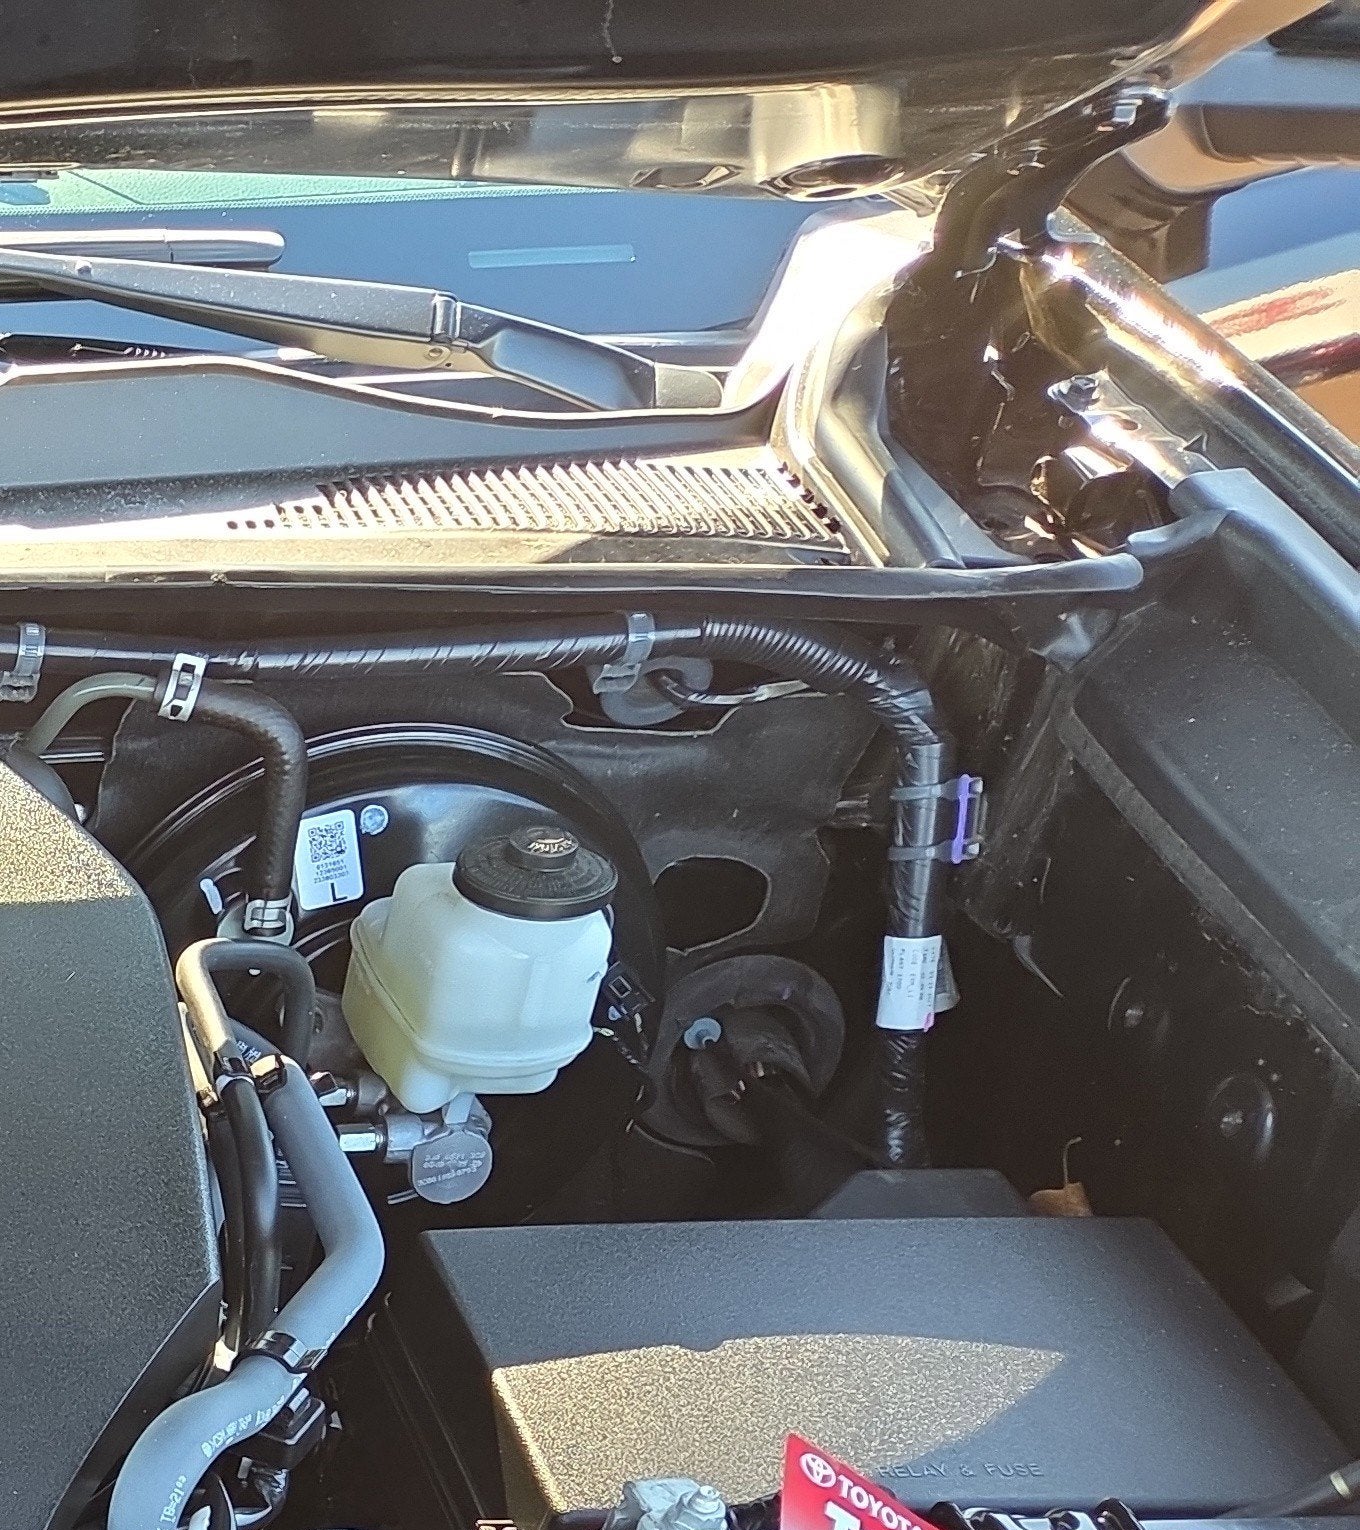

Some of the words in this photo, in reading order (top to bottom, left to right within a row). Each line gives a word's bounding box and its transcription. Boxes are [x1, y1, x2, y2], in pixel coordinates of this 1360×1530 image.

[330, 883, 347, 902] L
[878, 1463, 947, 1478] RELAY
[960, 1464, 976, 1477] &
[984, 1463, 1044, 1477] FUSE
